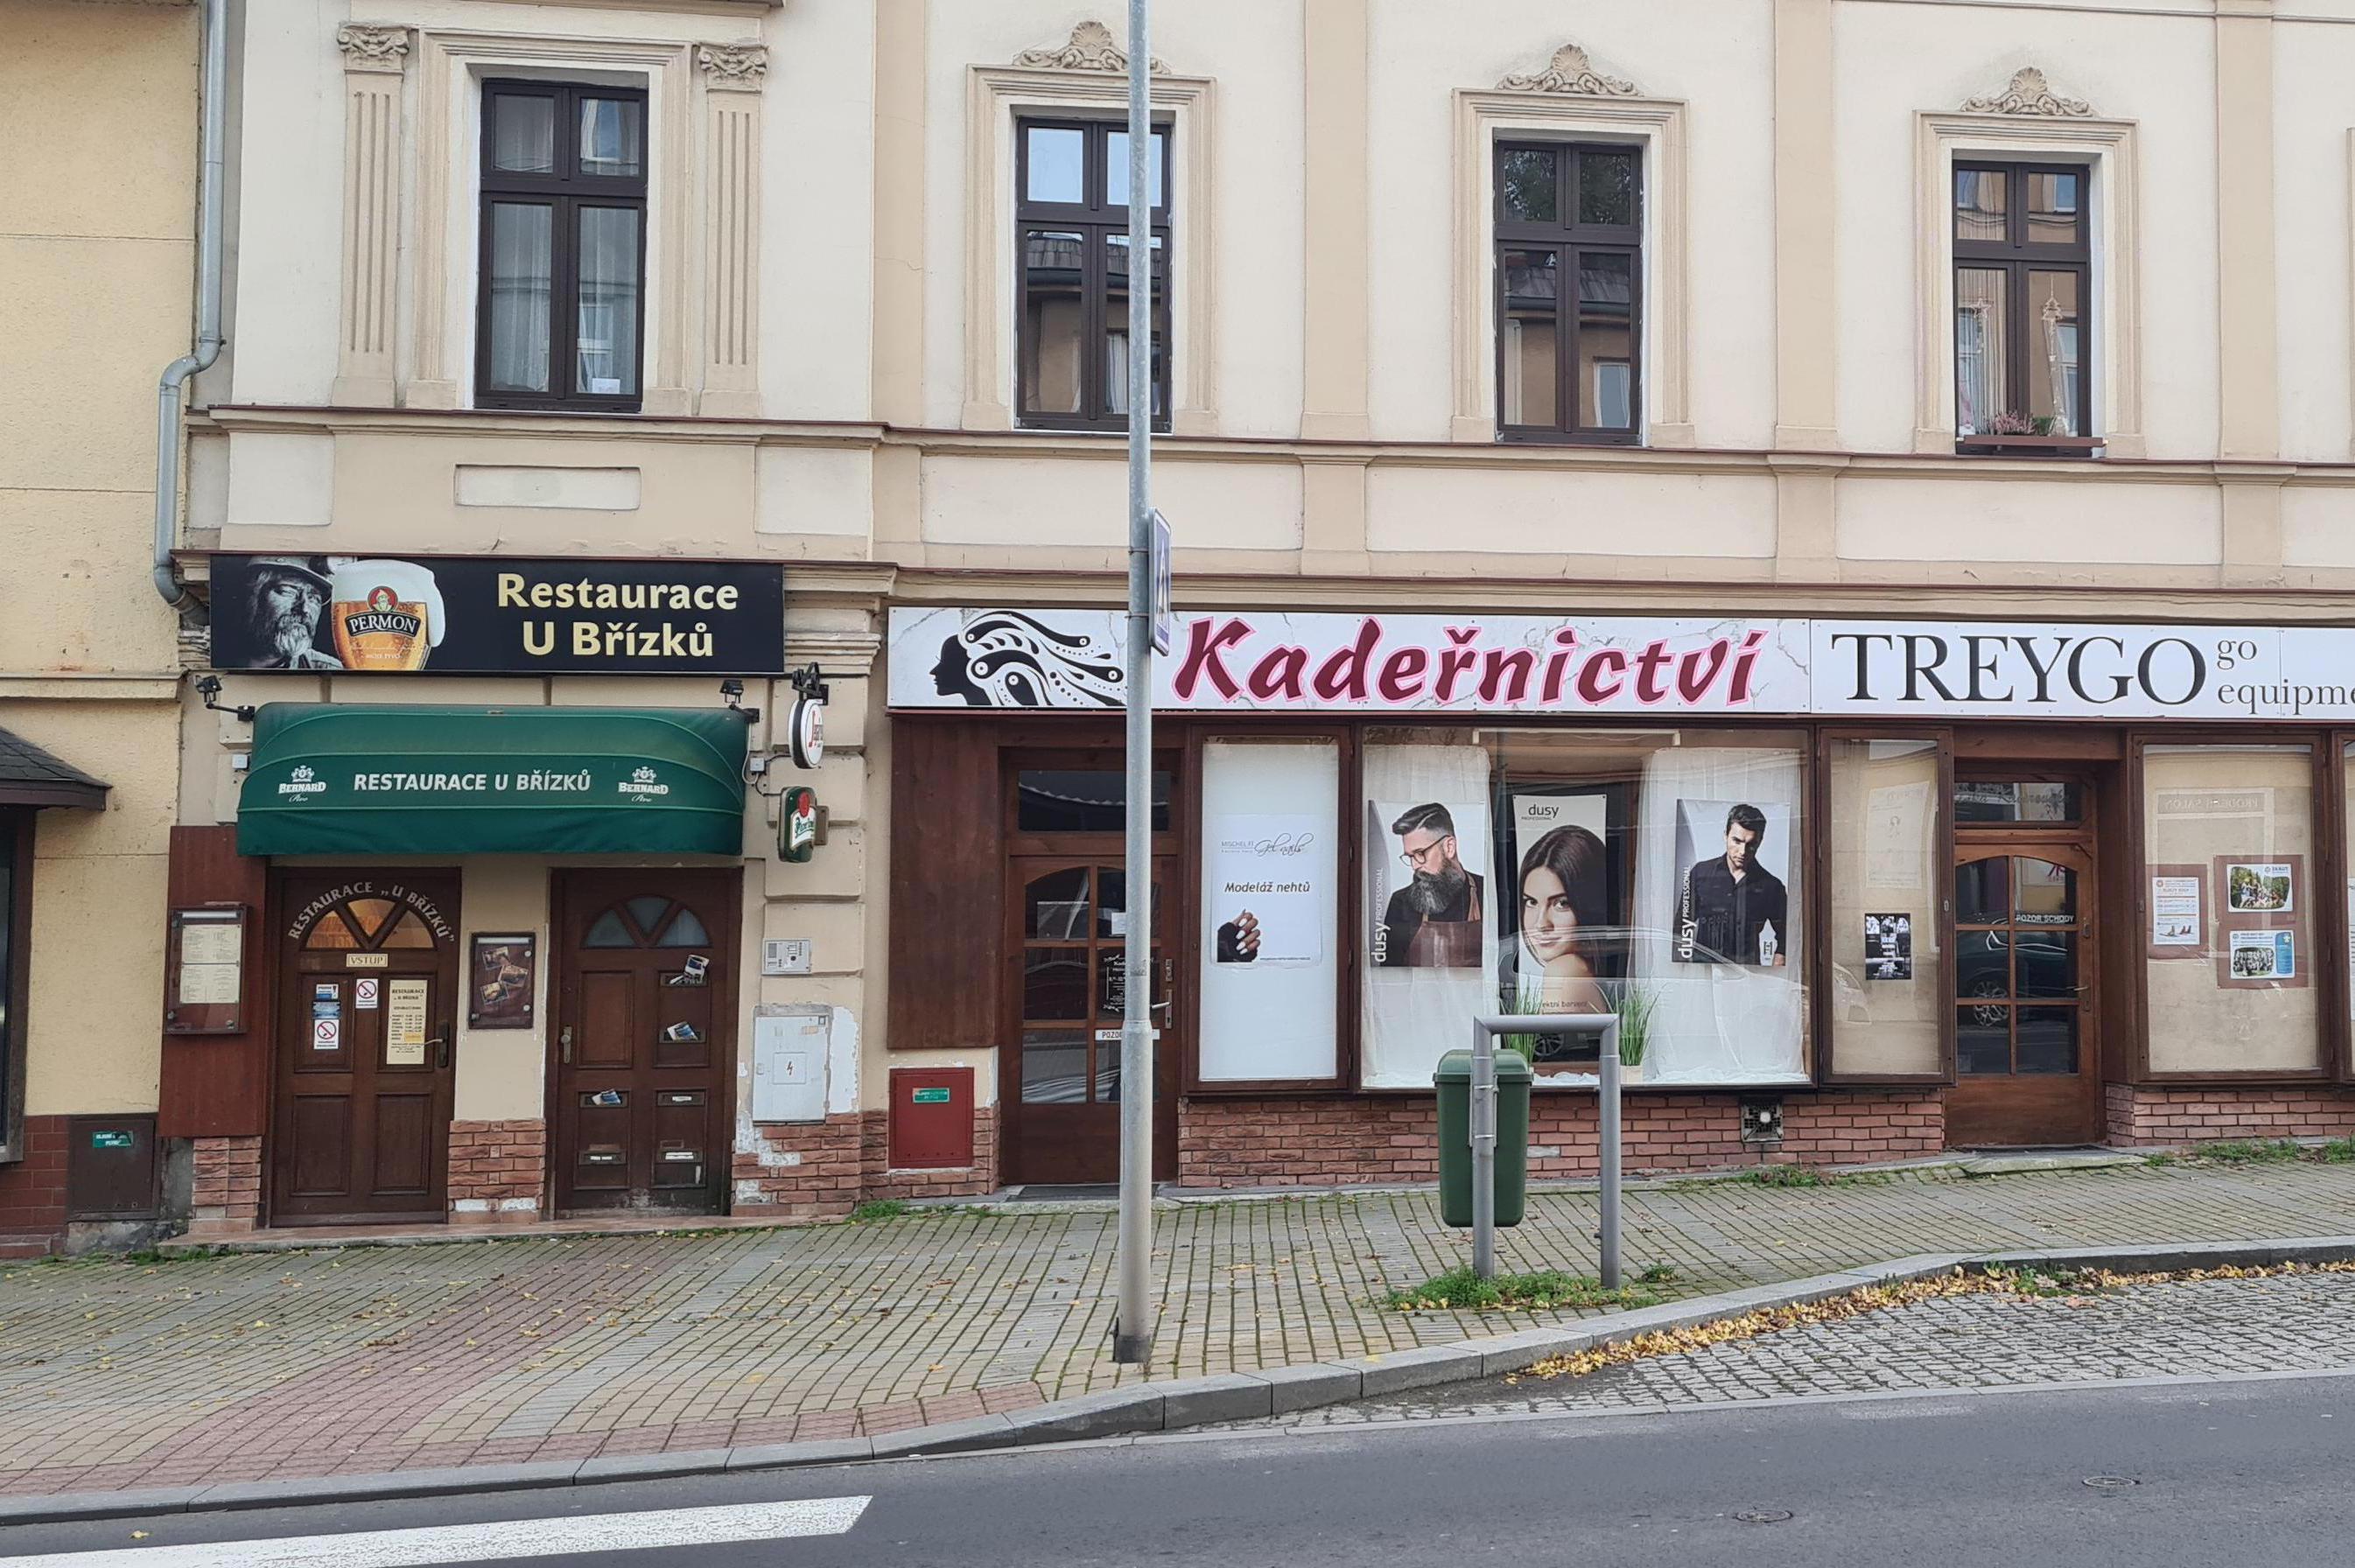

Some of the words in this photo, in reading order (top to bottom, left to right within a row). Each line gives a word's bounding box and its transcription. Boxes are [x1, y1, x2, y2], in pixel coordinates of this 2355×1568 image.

[498, 573, 739, 611] Restaurace
[348, 614, 417, 634] PERMON
[522, 624, 555, 655] U
[573, 621, 714, 657] Břízků
[1172, 615, 1769, 707] Kadeřnictví
[1832, 634, 2206, 704] TREYGO
[2217, 640, 2257, 670] go
[278, 780, 326, 794] BERNARD
[354, 773, 487, 791] RESTAURACE
[495, 773, 511, 790] U
[515, 766, 592, 791] BŘÍZKŮ
[618, 781, 669, 795] BERNARD
[1528, 803, 1559, 819] dusy
[1224, 881, 1273, 892] Modeláž
[1276, 881, 1311, 892] nehtů
[1375, 867, 1384, 920] PROFESSIONAL
[1682, 864, 1691, 918] PROFESSIONAL
[288, 881, 374, 940] RESTAURACE
[2044, 914, 2074, 923] SCHODY
[1370, 922, 1391, 962] dusy
[1678, 918, 1697, 959] dusy
[1102, 1031, 1123, 1040] POZO
